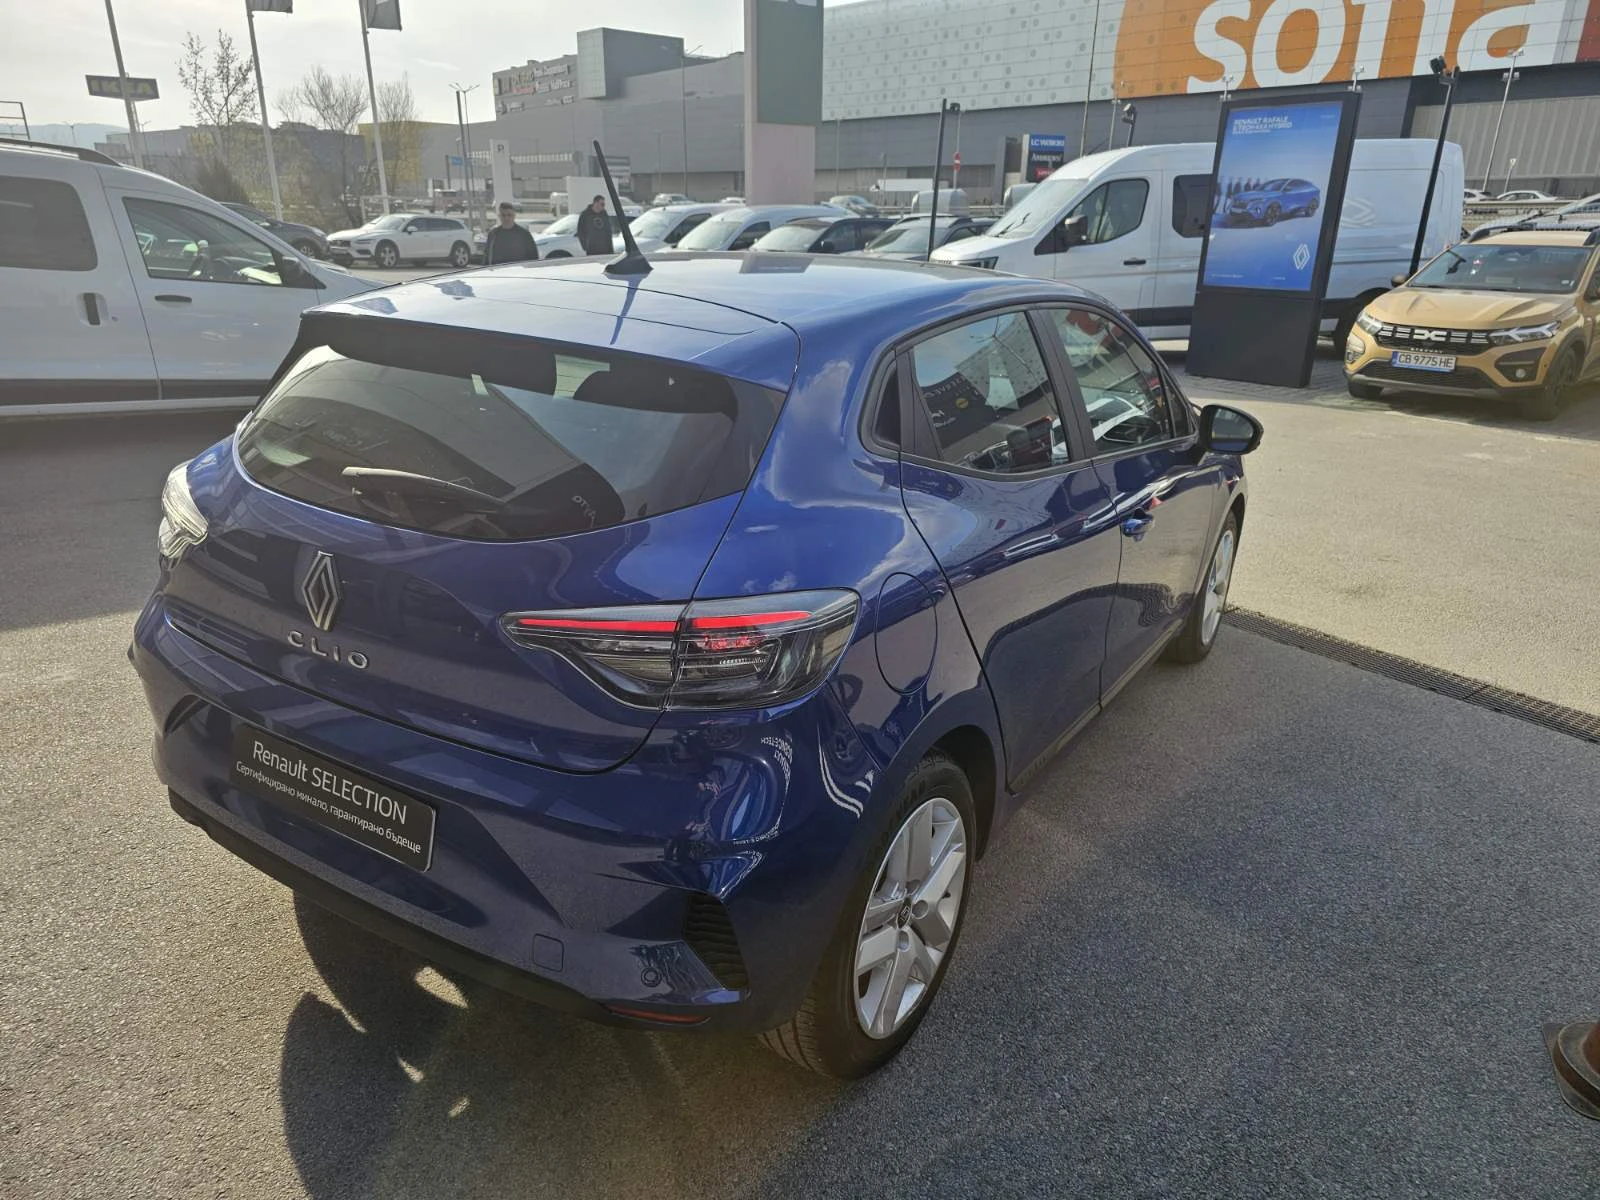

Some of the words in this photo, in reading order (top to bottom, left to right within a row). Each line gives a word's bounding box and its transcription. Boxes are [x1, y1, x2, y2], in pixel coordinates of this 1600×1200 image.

[1414, 355, 1438, 366] 9775
[1439, 357, 1454, 368] HE
[287, 630, 368, 669] CLIO
[236, 760, 296, 797] Сертифицирано
[296, 790, 329, 813] минало,
[329, 806, 384, 836] гарантирано
[385, 827, 421, 854] бъдеще
[252, 740, 309, 783] Renault
[311, 767, 407, 825] SELECTION
